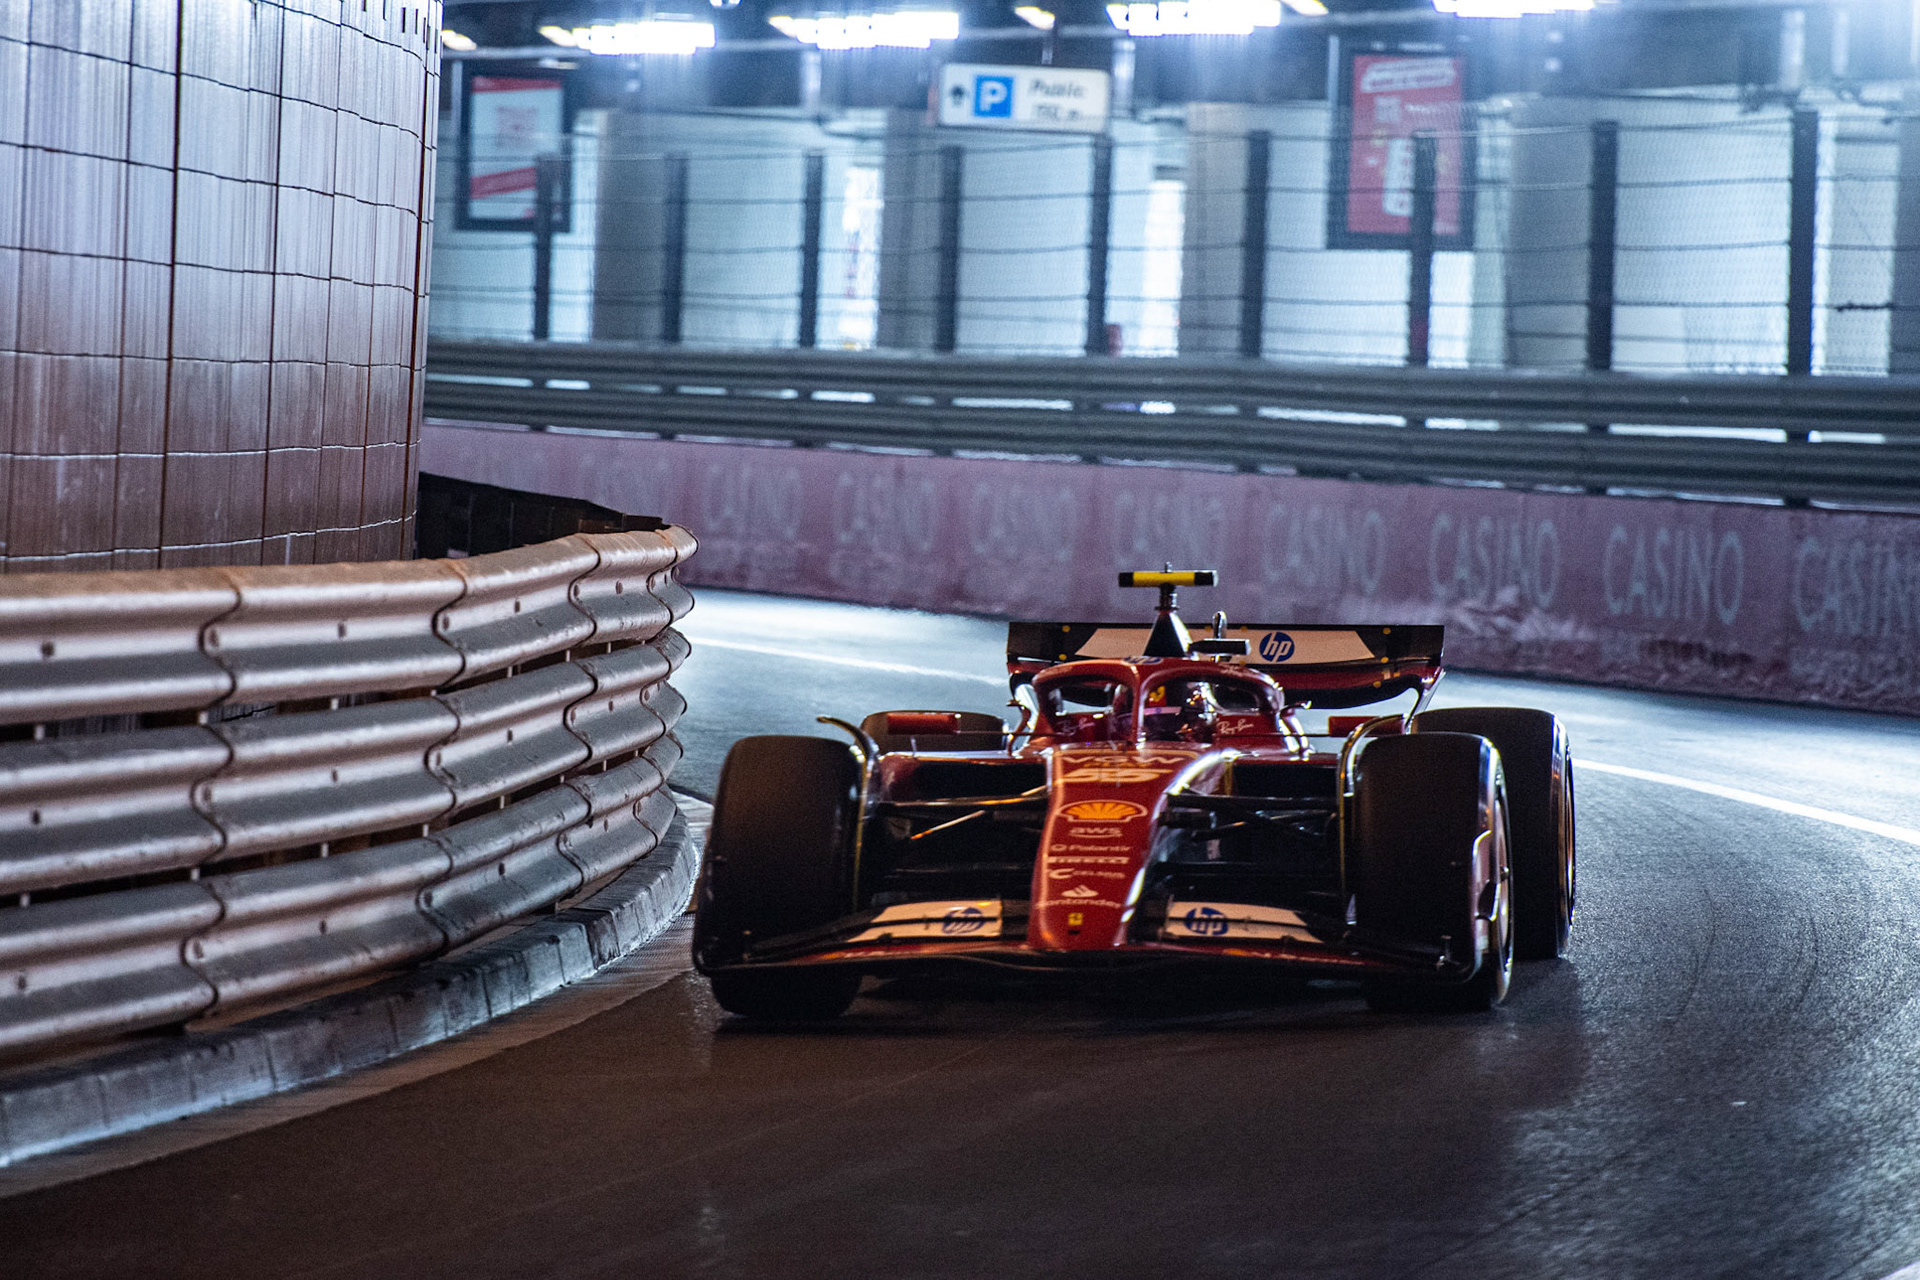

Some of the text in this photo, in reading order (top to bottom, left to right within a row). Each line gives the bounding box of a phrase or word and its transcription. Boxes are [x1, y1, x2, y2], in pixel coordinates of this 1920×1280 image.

[979, 81, 1008, 112] P
[1428, 512, 1561, 608] CASINO
[1603, 524, 1744, 626] CASINO
[1260, 631, 1295, 662] hp
[1217, 718, 1255, 735] Ray-Ban
[1060, 768, 1174, 783] 55
